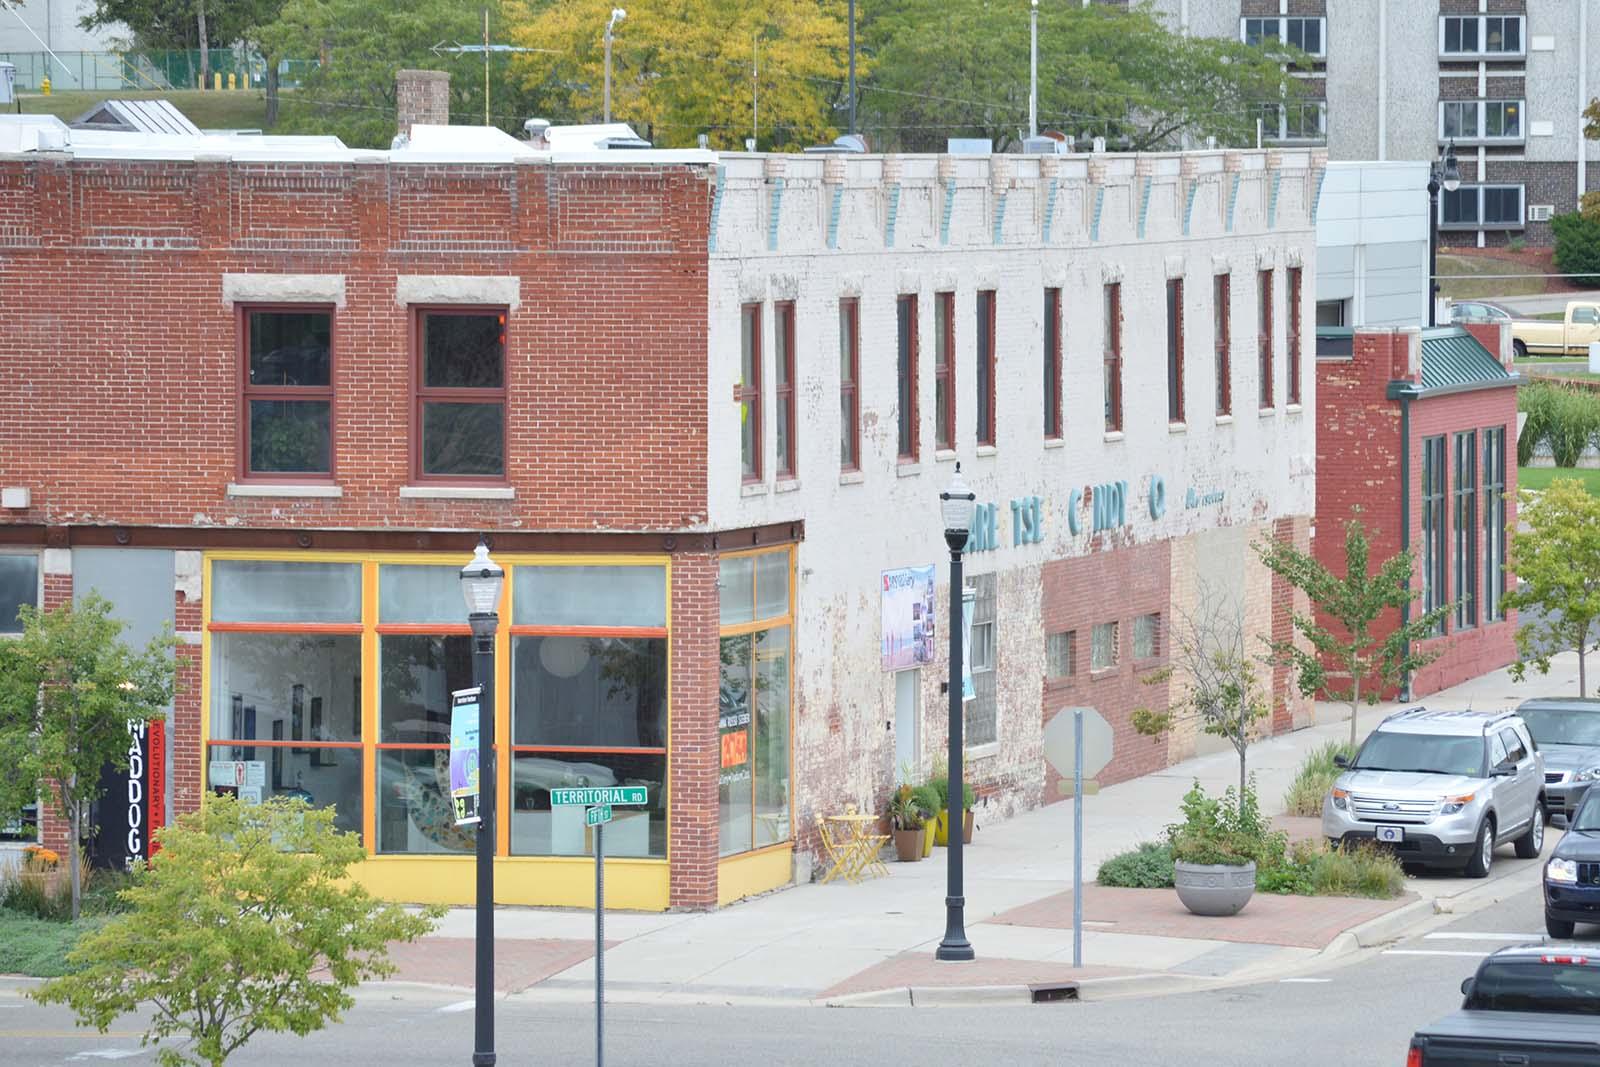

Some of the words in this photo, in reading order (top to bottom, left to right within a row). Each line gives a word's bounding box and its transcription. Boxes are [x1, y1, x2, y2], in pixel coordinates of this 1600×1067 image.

[152, 720, 162, 810] EVOLUTIONARY
[555, 789, 628, 804] TERRITORIAL
[631, 792, 643, 802] RD
